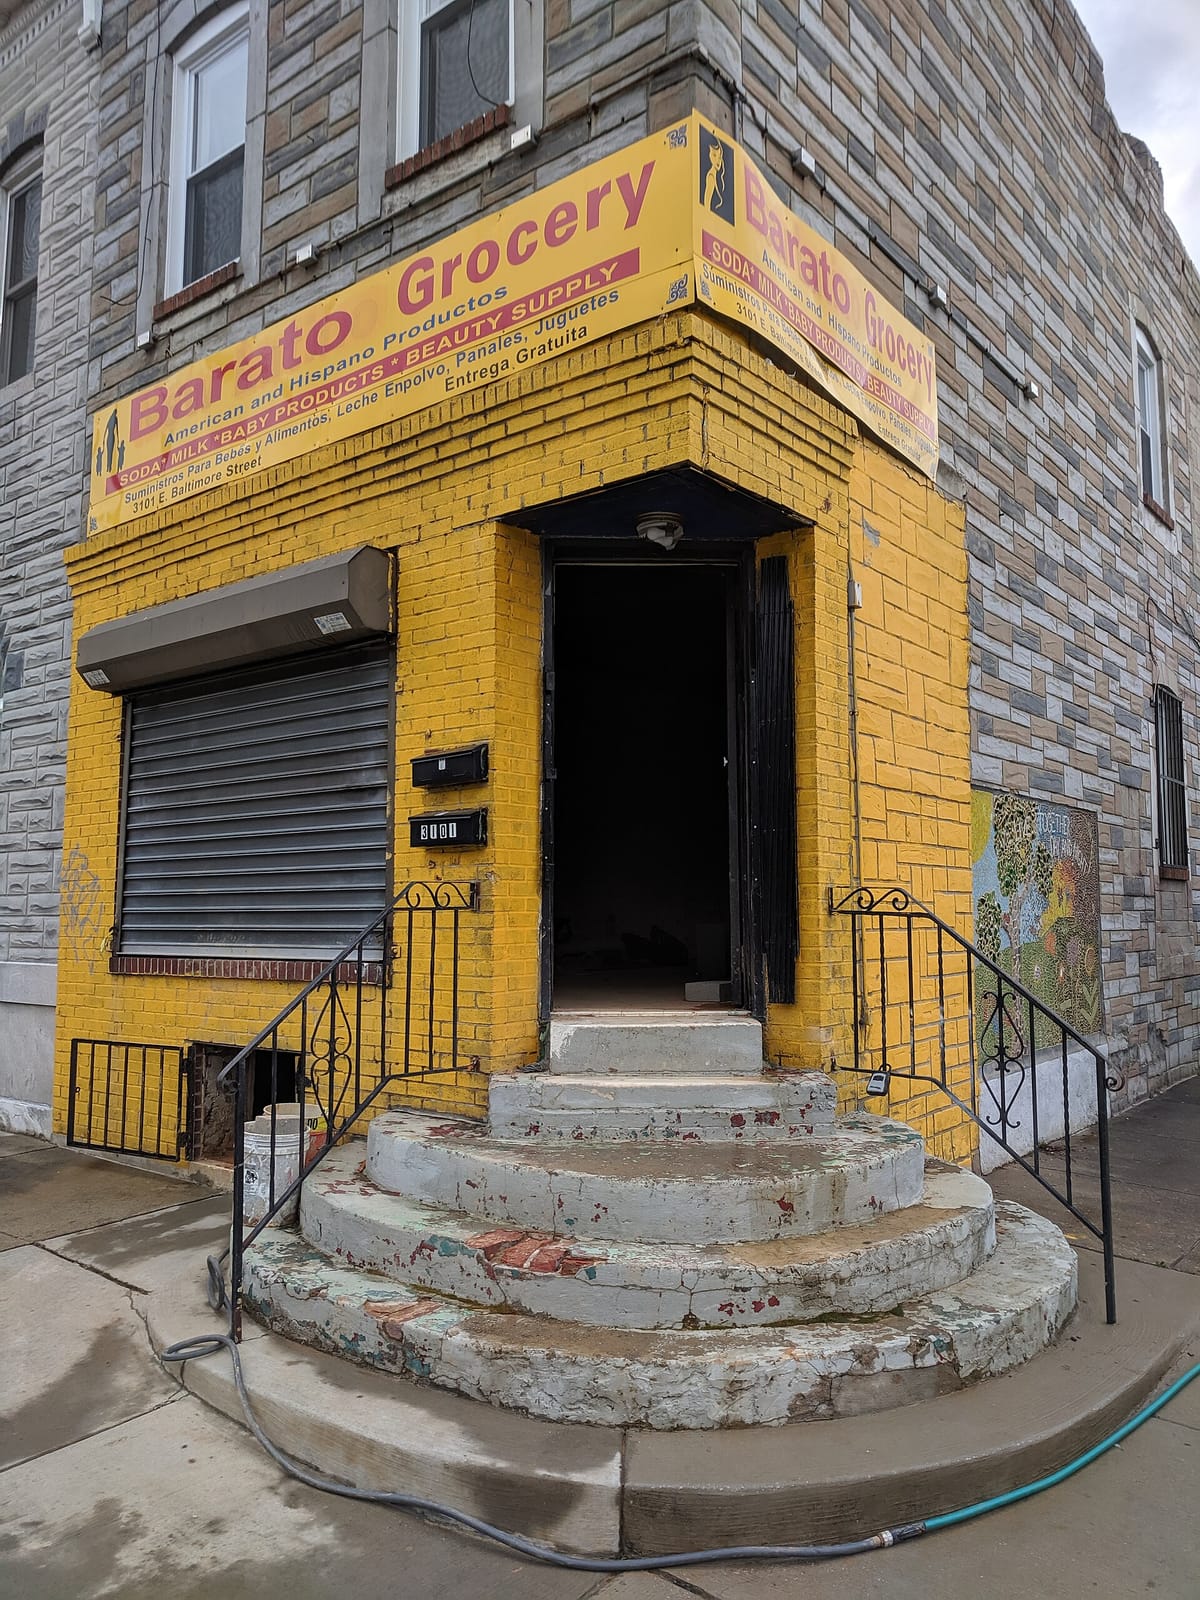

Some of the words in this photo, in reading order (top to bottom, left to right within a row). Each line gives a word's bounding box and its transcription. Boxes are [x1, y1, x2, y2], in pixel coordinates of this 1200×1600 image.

[129, 311, 353, 442] Barato
[397, 159, 656, 316] Grocery
[702, 262, 760, 310] Suministros
[736, 302, 757, 324] 3101
[745, 164, 850, 315] Barato
[864, 290, 934, 403] Grocery
[758, 271, 783, 310] MILK
[815, 326, 860, 380] PRODUCTS
[867, 375, 902, 411] BEAUTY
[903, 401, 932, 434] SUPPLY
[762, 249, 804, 302] American
[806, 297, 822, 318] and
[828, 311, 860, 352] Hispano
[862, 346, 902, 387] Productos
[125, 473, 184, 504] Suministros
[187, 460, 211, 477] Para
[255, 440, 262, 454] y
[264, 413, 331, 446] Alimentos,
[337, 392, 378, 417] Leche
[385, 364, 450, 398] Enpolvo,
[456, 330, 528, 368] Panales,
[534, 289, 619, 336] Juguetes
[164, 405, 244, 447] American
[251, 384, 283, 410] and
[289, 347, 375, 391] Hispano
[383, 286, 508, 351] Productos
[171, 438, 209, 465] MILK
[275, 365, 384, 422] PRODUCTS
[406, 312, 503, 366] BEAUTY
[511, 262, 618, 321] SUPPLY
[445, 358, 509, 392] Entrega
[516, 325, 588, 364] Gratuita
[132, 496, 155, 514] 3101
[158, 492, 168, 505] E.
[171, 472, 222, 498] Baltimore
[226, 455, 262, 477] Street
[421, 823, 457, 840] 3101
